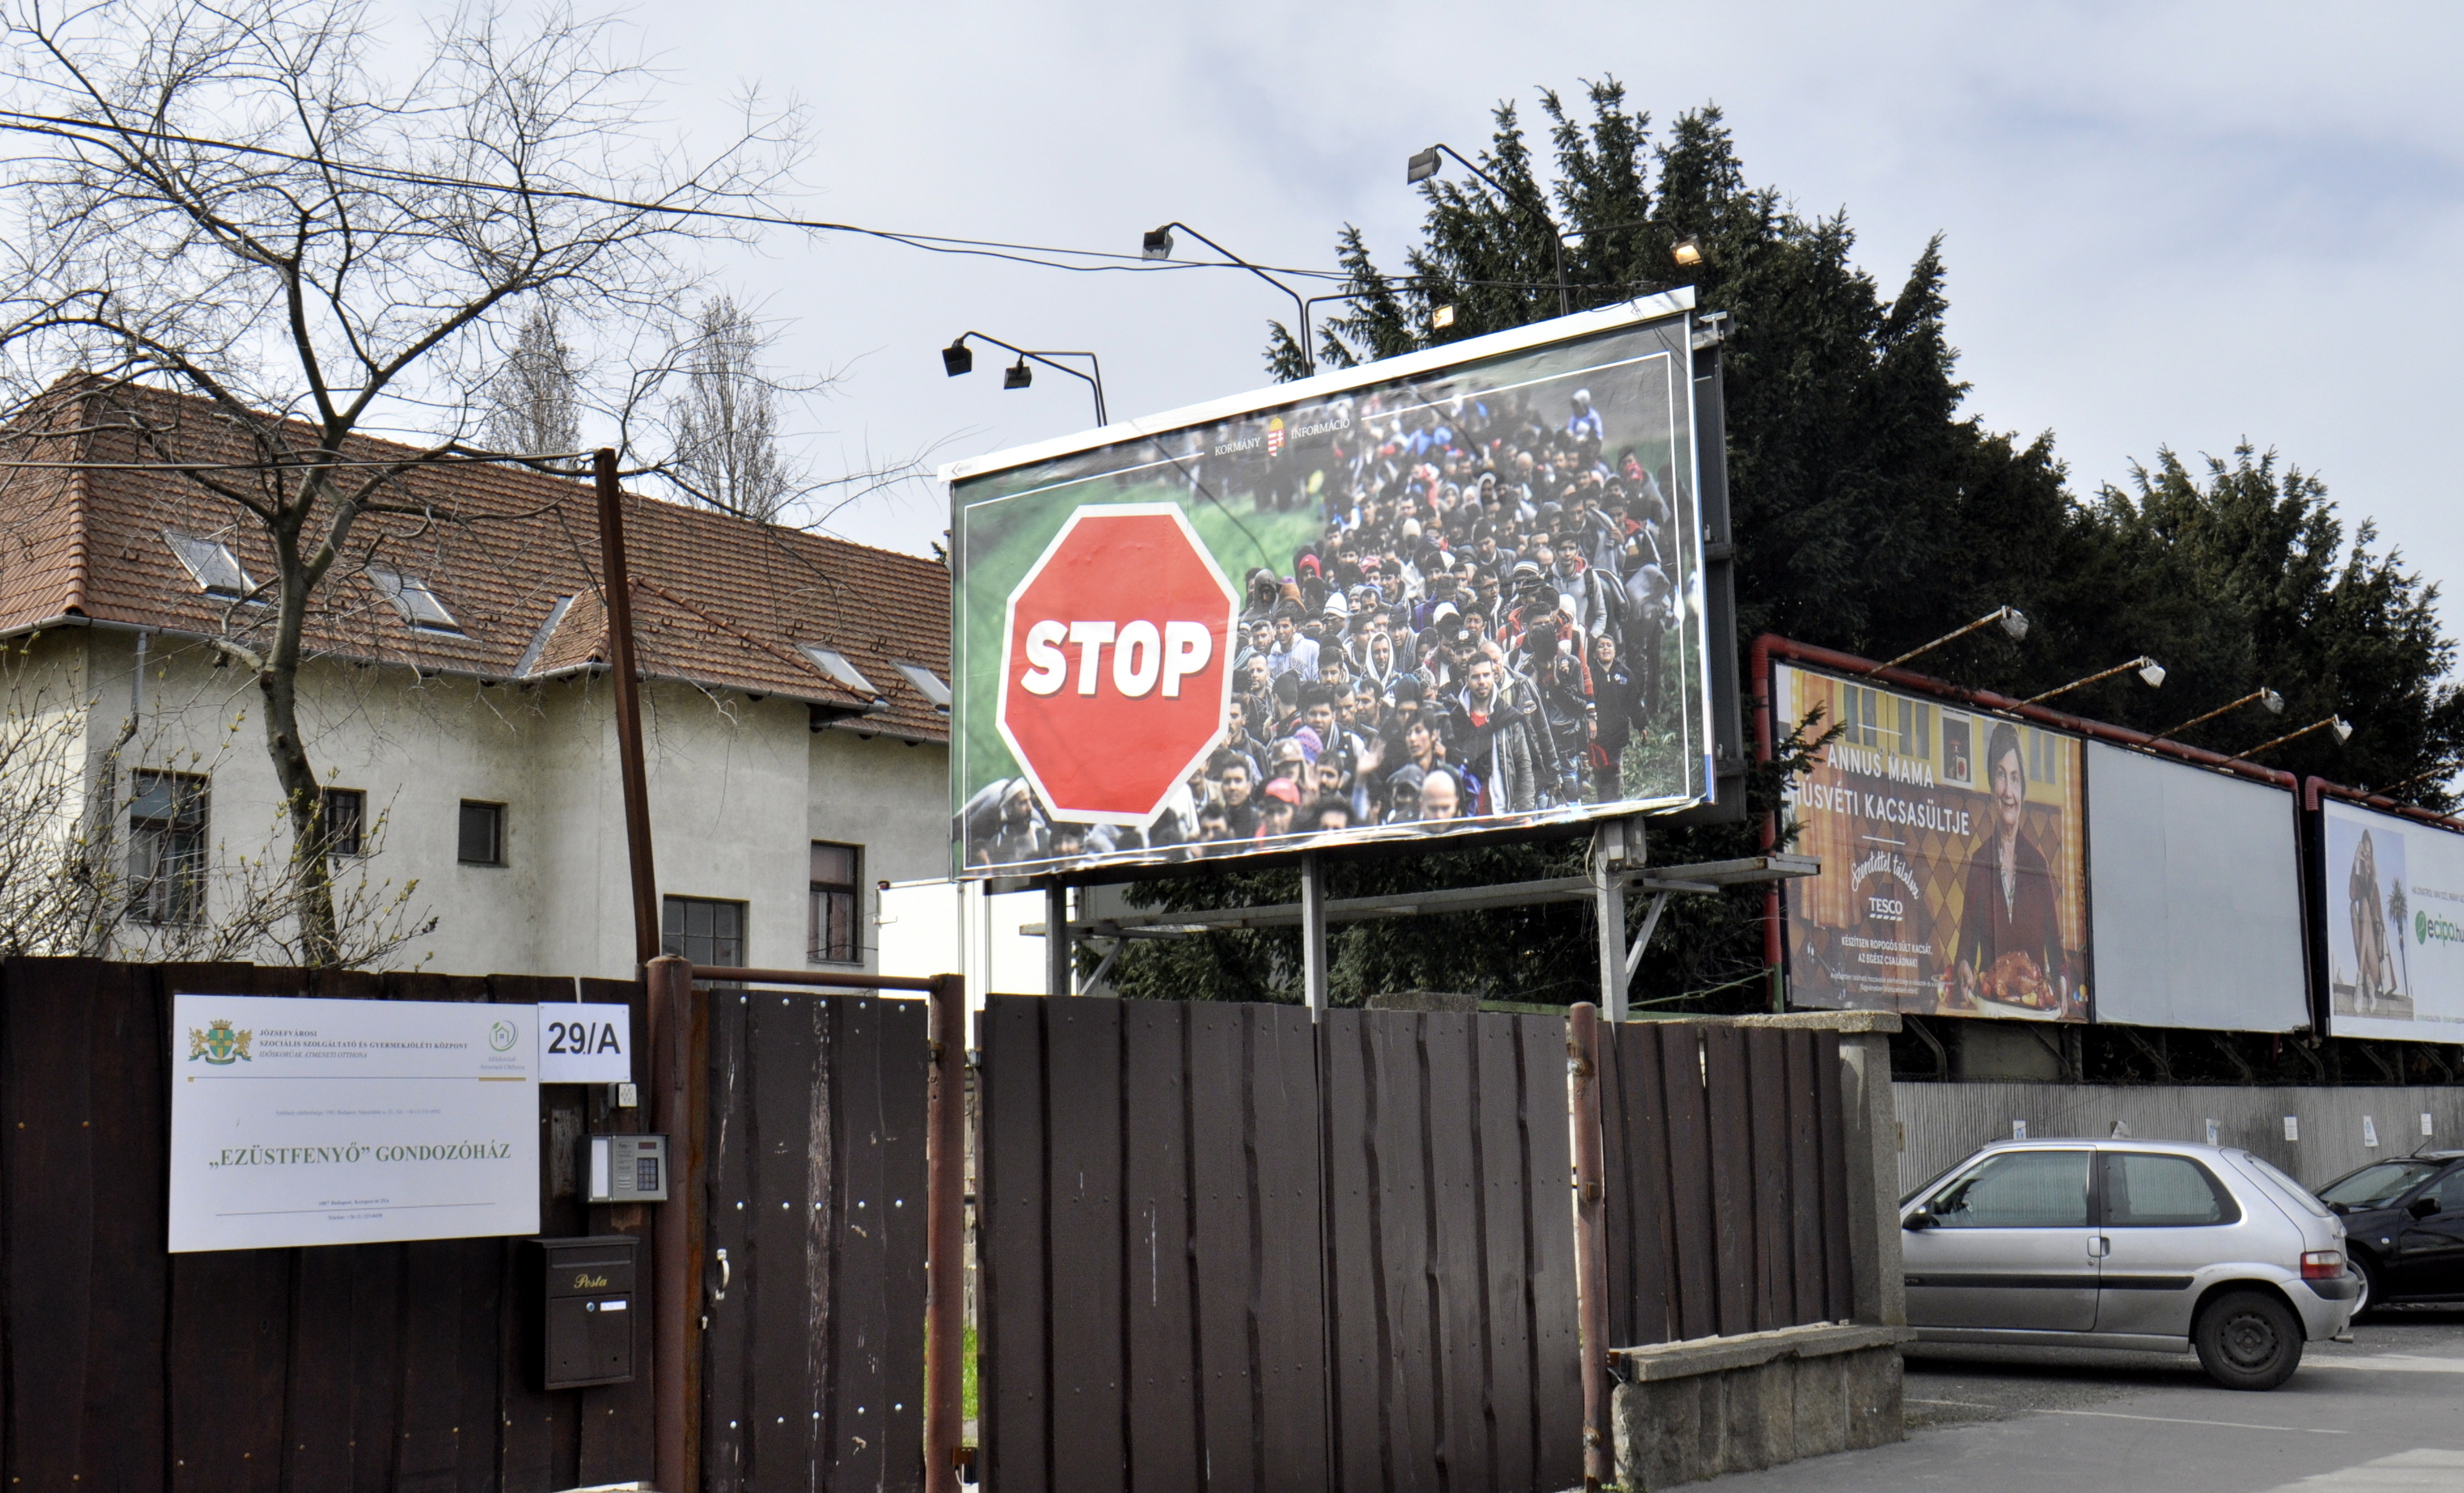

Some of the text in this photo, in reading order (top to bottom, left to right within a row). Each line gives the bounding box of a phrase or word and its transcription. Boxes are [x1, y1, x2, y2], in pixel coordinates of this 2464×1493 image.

[1215, 437, 1260, 456] KORMÁNY
[1020, 619, 1213, 699] STOP
[1828, 744, 1934, 788] ANNUS MAMA
[1866, 793, 1970, 836] KACSASÜLTJE
[1851, 851, 1919, 900] Szeretettel tálalva
[1868, 896, 1903, 915] TESCO
[376, 1140, 511, 1162] GONDOZÓHÁZ
[574, 1273, 608, 1289] Posta
